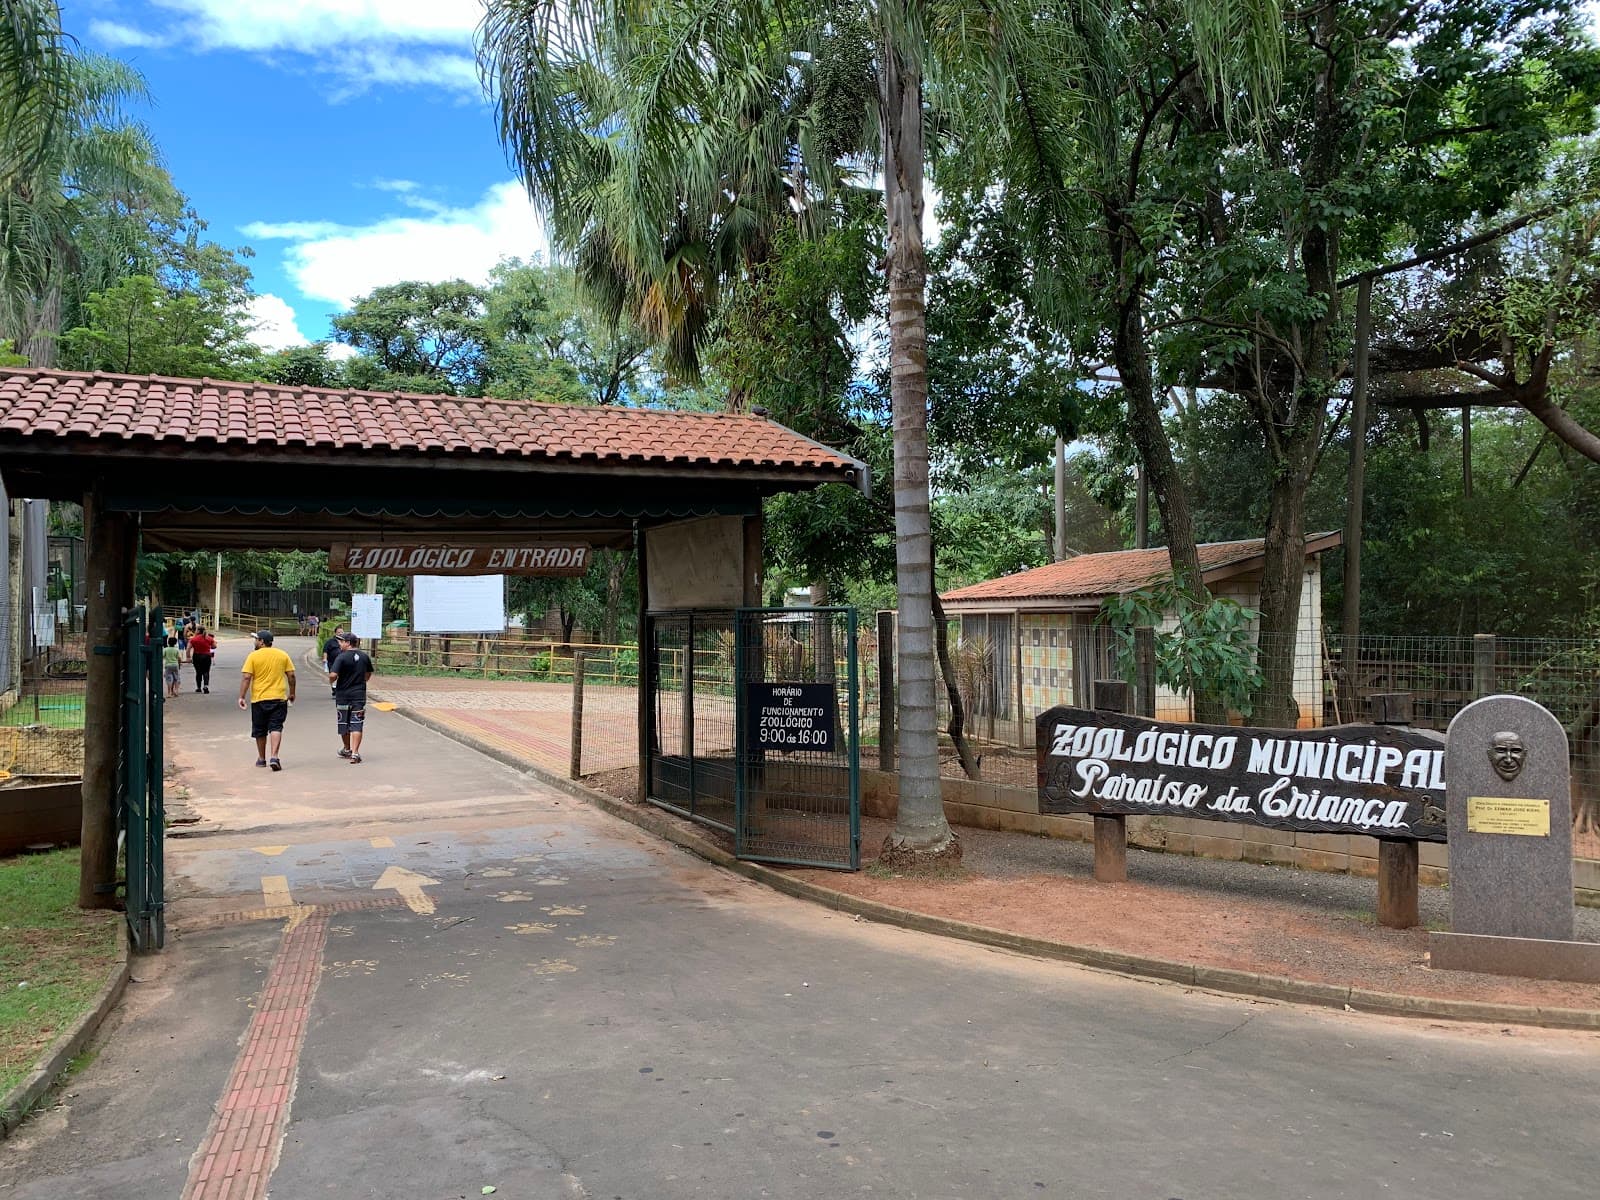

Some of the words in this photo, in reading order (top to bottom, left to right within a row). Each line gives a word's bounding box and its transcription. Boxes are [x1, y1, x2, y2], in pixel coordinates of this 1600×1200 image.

[487, 547, 586, 569] ENTRADA
[772, 686, 802, 696] HORÁRIO
[783, 698, 793, 706] DE
[761, 707, 824, 717] FUNCIONAMENTO
[760, 715, 813, 728] ZOOLÓGICO
[760, 728, 786, 743] 9:00
[797, 730, 827, 744] 16:00
[1071, 758, 1208, 809] Paraíso
[1206, 786, 1256, 815] da
[1258, 777, 1410, 830] Criança
